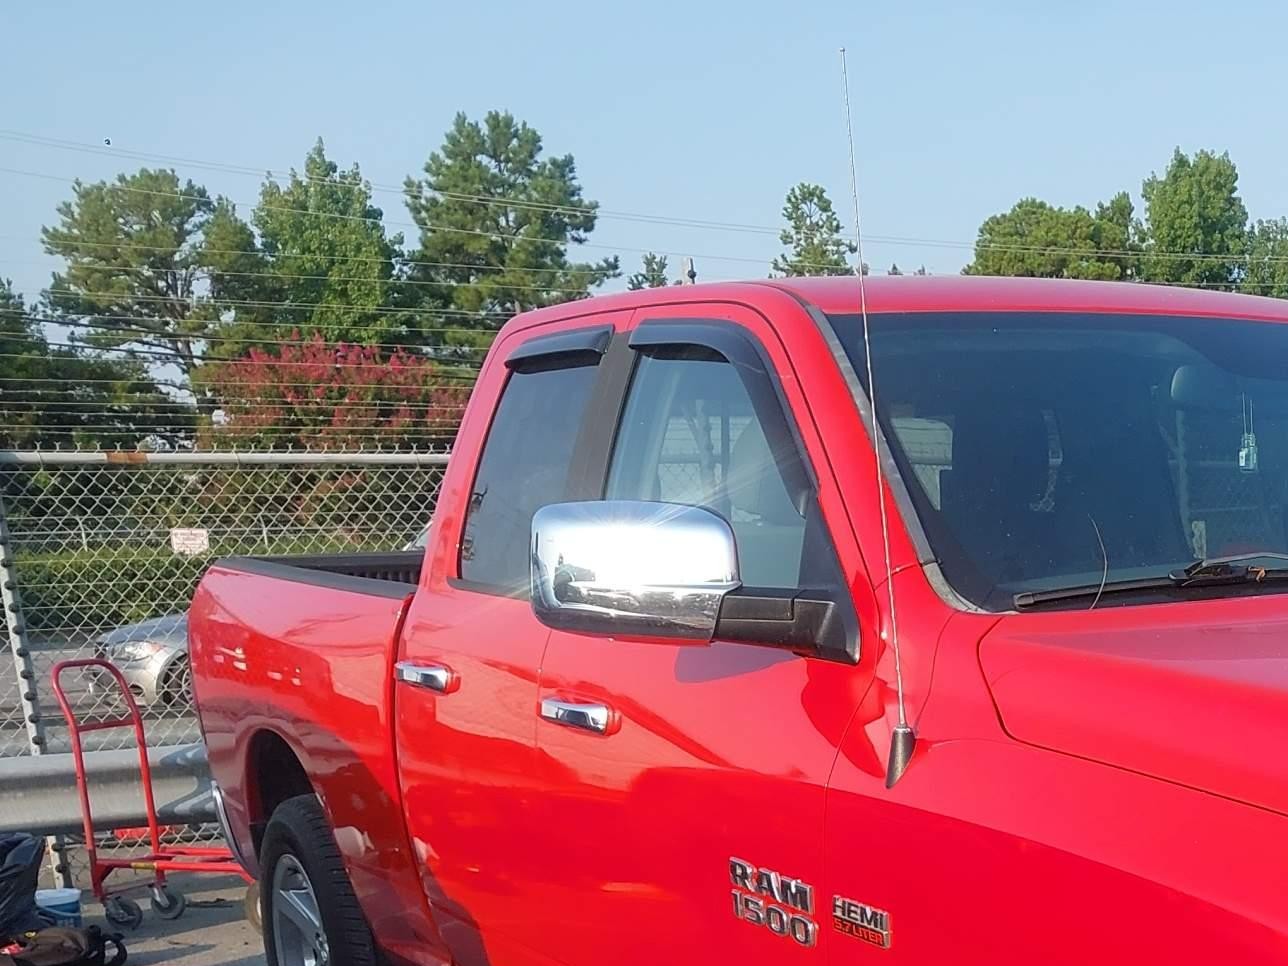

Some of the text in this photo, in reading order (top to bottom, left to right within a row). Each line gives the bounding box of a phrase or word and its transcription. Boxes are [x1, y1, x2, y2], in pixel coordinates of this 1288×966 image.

[729, 856, 814, 915] RAM
[731, 889, 819, 947] 1500
[833, 895, 889, 931] HEMI
[852, 924, 884, 945] LITER
